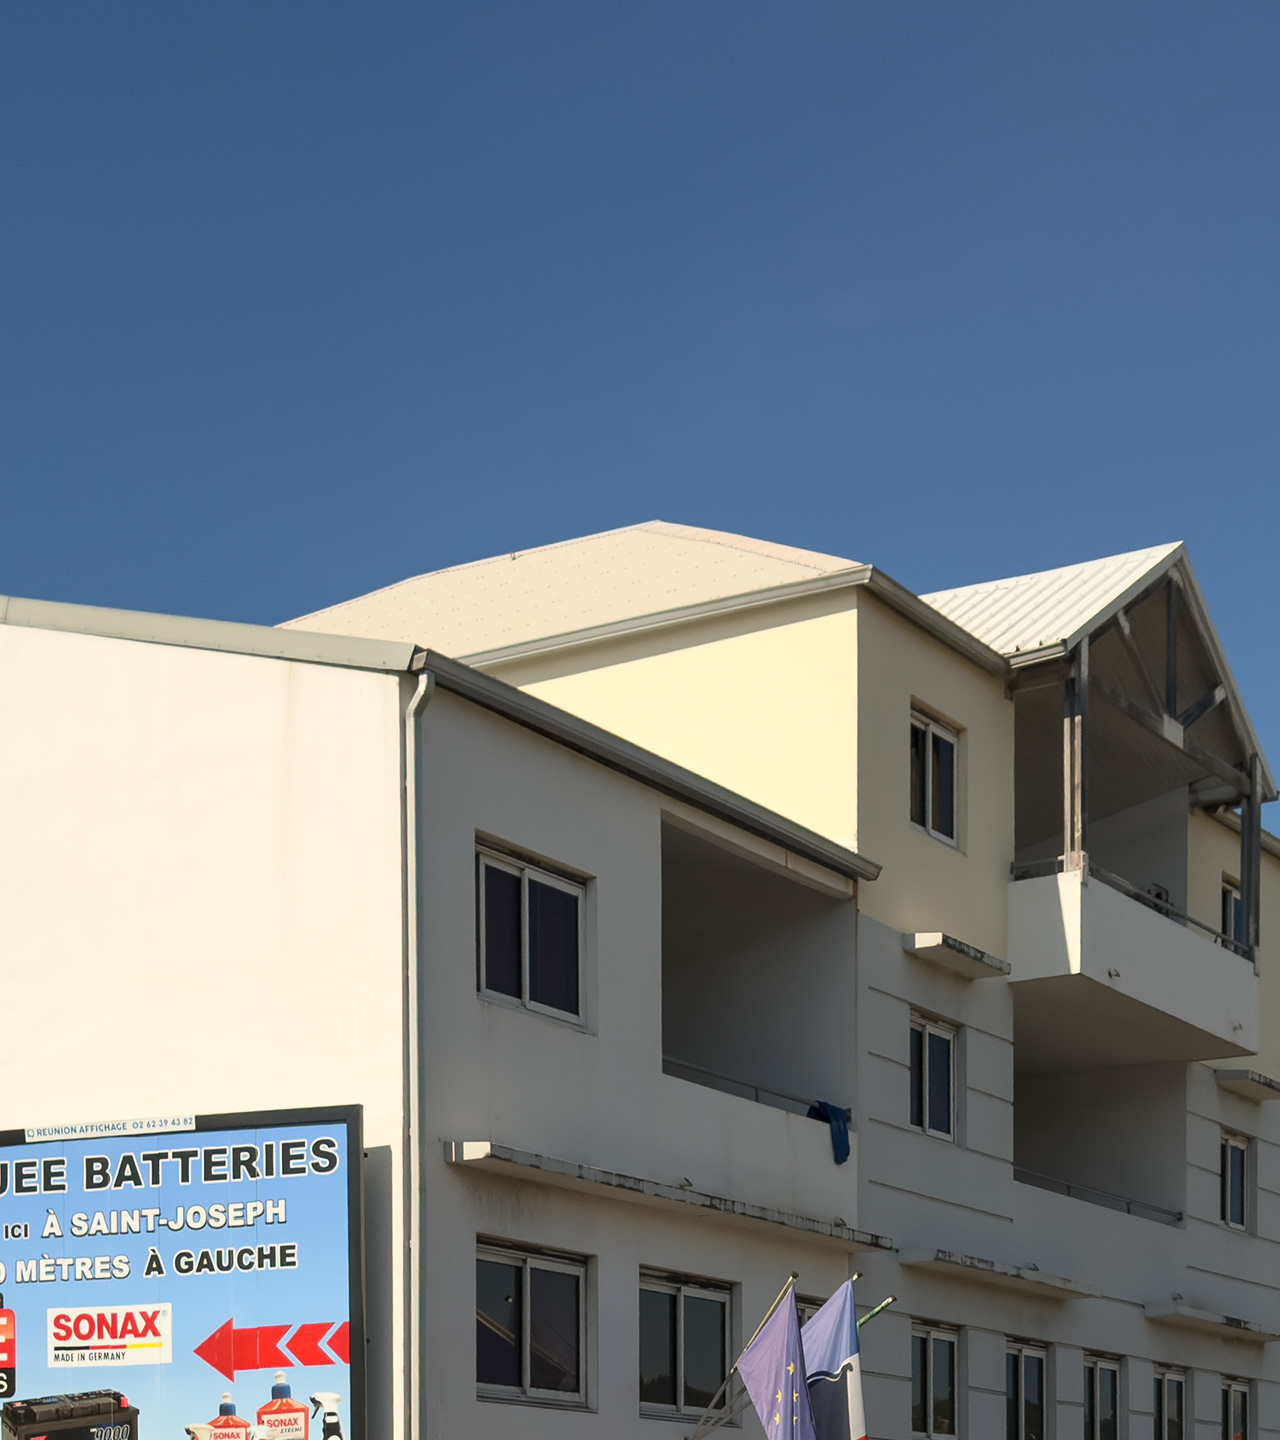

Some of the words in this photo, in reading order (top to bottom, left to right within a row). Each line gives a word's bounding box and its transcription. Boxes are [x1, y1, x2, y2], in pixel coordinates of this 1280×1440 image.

[36, 1126, 77, 1137] REUNION
[79, 1122, 127, 1134] AFFICHAGE
[146, 1120, 157, 1128] 62
[158, 1119, 169, 1127] 39
[171, 1118, 181, 1126] 43
[183, 1117, 193, 1126] 82
[84, 1138, 339, 1191] BATTERIES
[3, 1223, 29, 1240] ICI
[41, 1208, 63, 1238] À
[71, 1199, 287, 1237] SAINT-JOSEPH
[16, 1254, 130, 1284] MÈTRES
[143, 1248, 165, 1277] À
[174, 1243, 297, 1275] GAUCHE
[53, 1310, 161, 1341] SONAX
[53, 1353, 75, 1362] MADE
[77, 1352, 85, 1361] IN
[88, 1351, 126, 1361] GERMANY
[267, 1417, 299, 1428] SONAX
[213, 1431, 241, 1440] SONAX
